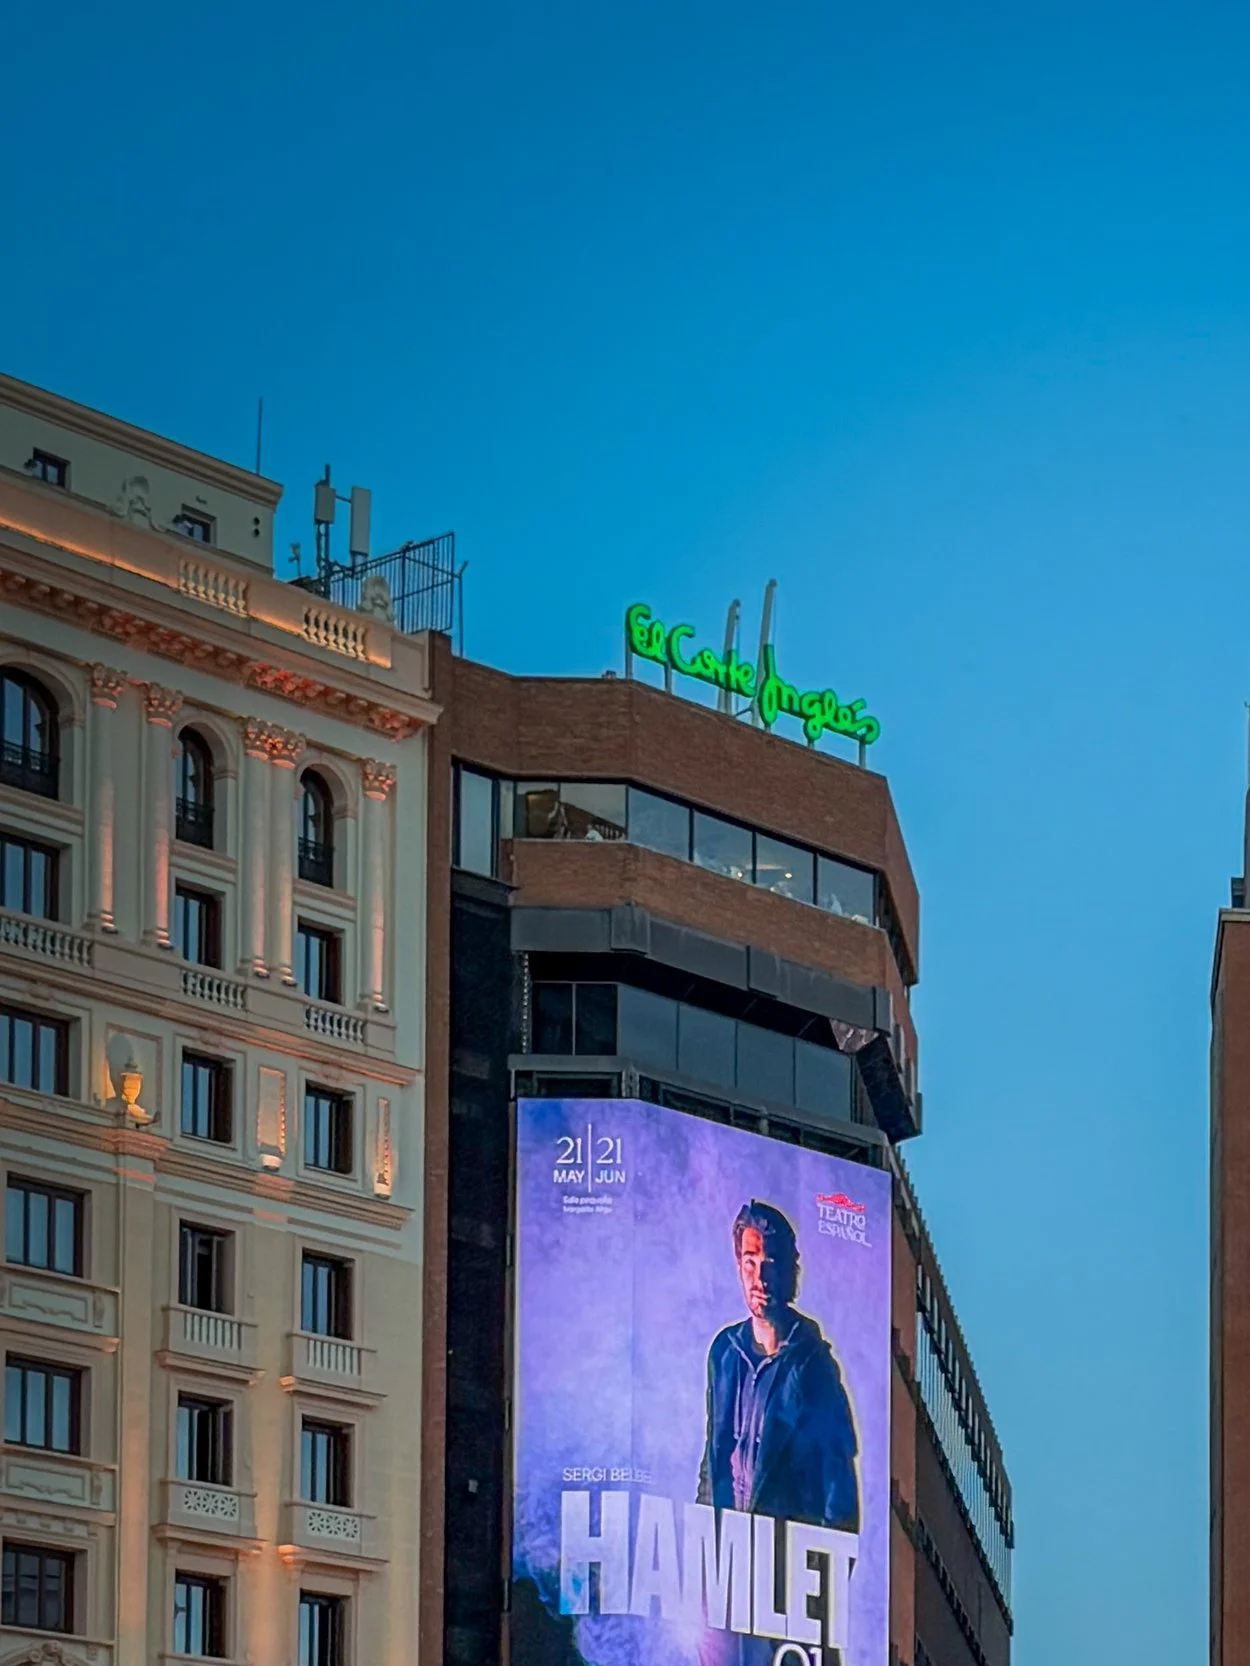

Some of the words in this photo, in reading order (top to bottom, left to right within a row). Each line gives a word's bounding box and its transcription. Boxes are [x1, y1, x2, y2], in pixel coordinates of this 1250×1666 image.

[626, 603, 666, 665] El
[667, 623, 757, 698] Corte
[758, 644, 881, 745] Inglés
[556, 1136, 583, 1164] 21
[596, 1137, 622, 1164] 21
[553, 1169, 585, 1183] MAY
[595, 1169, 626, 1183] JUN
[816, 1202, 866, 1230] TEATRO
[562, 1467, 607, 1482] SERGI
[560, 1490, 859, 1650] HAMLET
